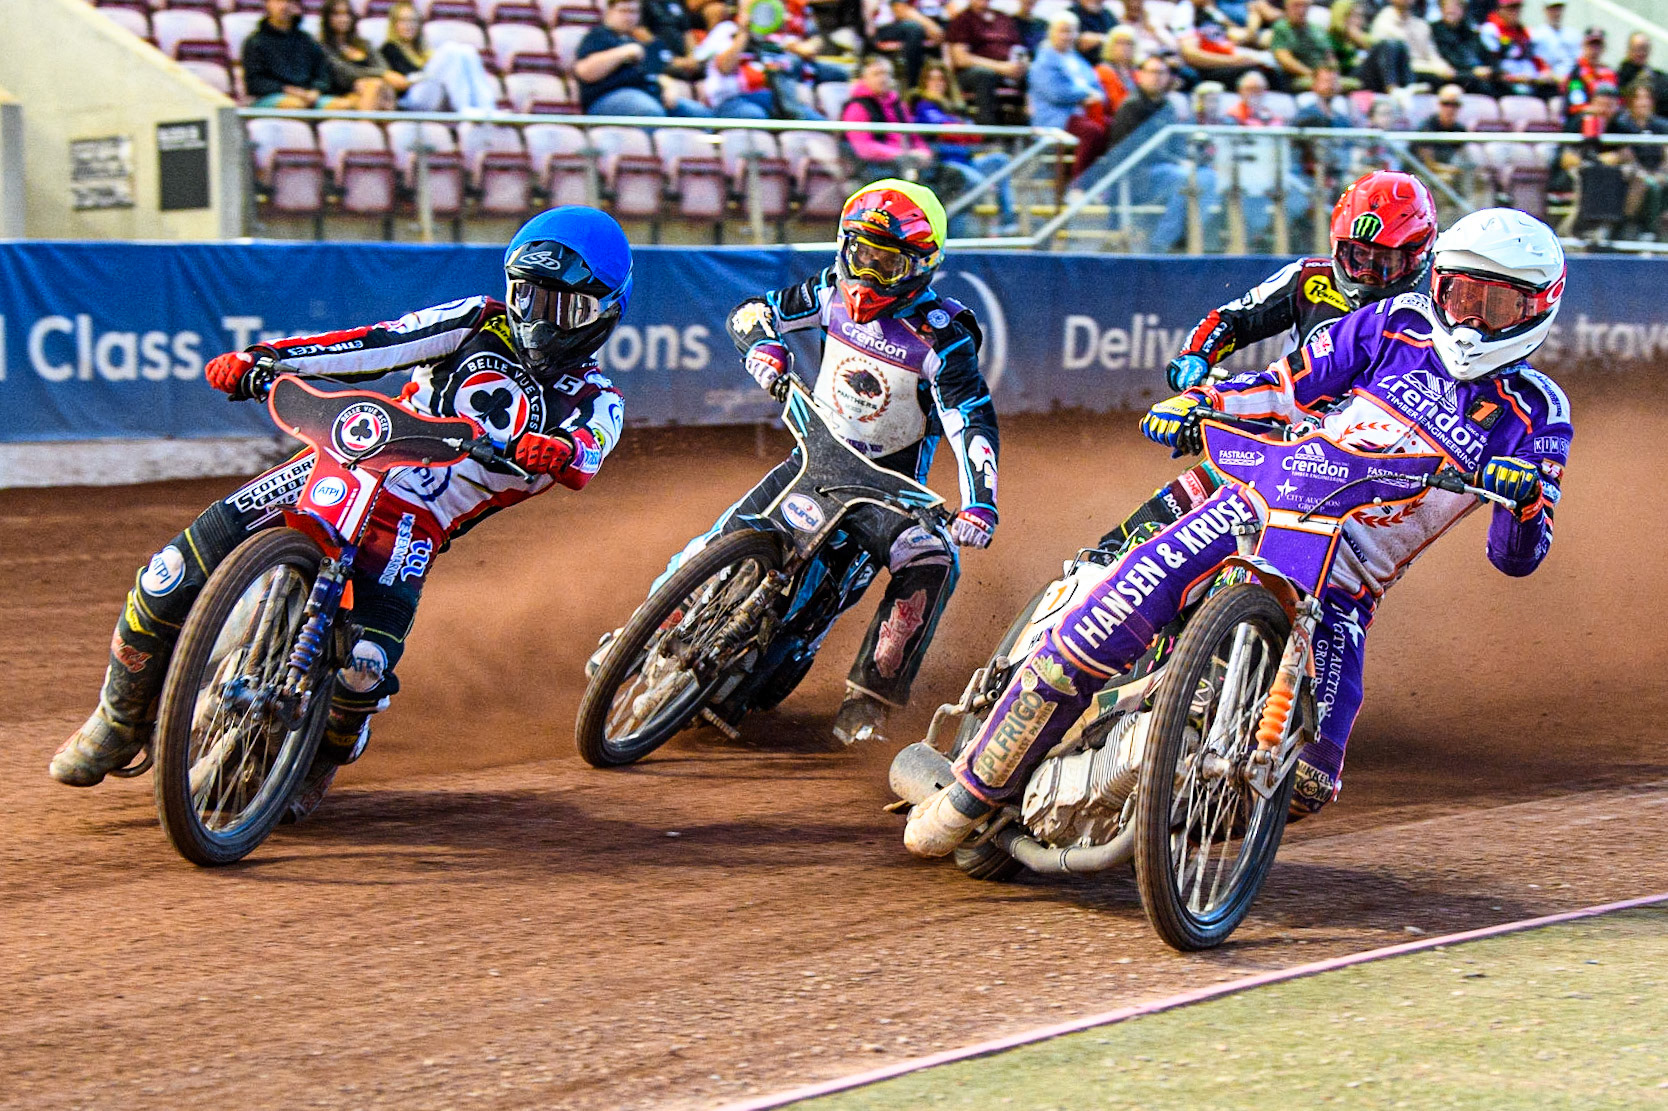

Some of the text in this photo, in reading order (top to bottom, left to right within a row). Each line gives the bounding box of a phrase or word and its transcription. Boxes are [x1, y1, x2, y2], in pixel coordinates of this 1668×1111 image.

[28, 313, 201, 382] Class
[841, 321, 908, 360] Crendon
[466, 357, 509, 373] BELLE
[514, 367, 536, 396] VUE
[527, 394, 540, 431] ACES
[560, 376, 578, 394] 5
[1386, 391, 1477, 471] TIMBER ENGINEERING
[1471, 400, 1499, 422] 1
[1219, 449, 1256, 460] FASTRACK
[1281, 455, 1350, 479] Crendon
[236, 471, 289, 514] SCOTT
[317, 485, 341, 498] ATPI
[1073, 494, 1254, 650] HANSEN & KRUSE
[1325, 653, 1344, 719] AUCTION
